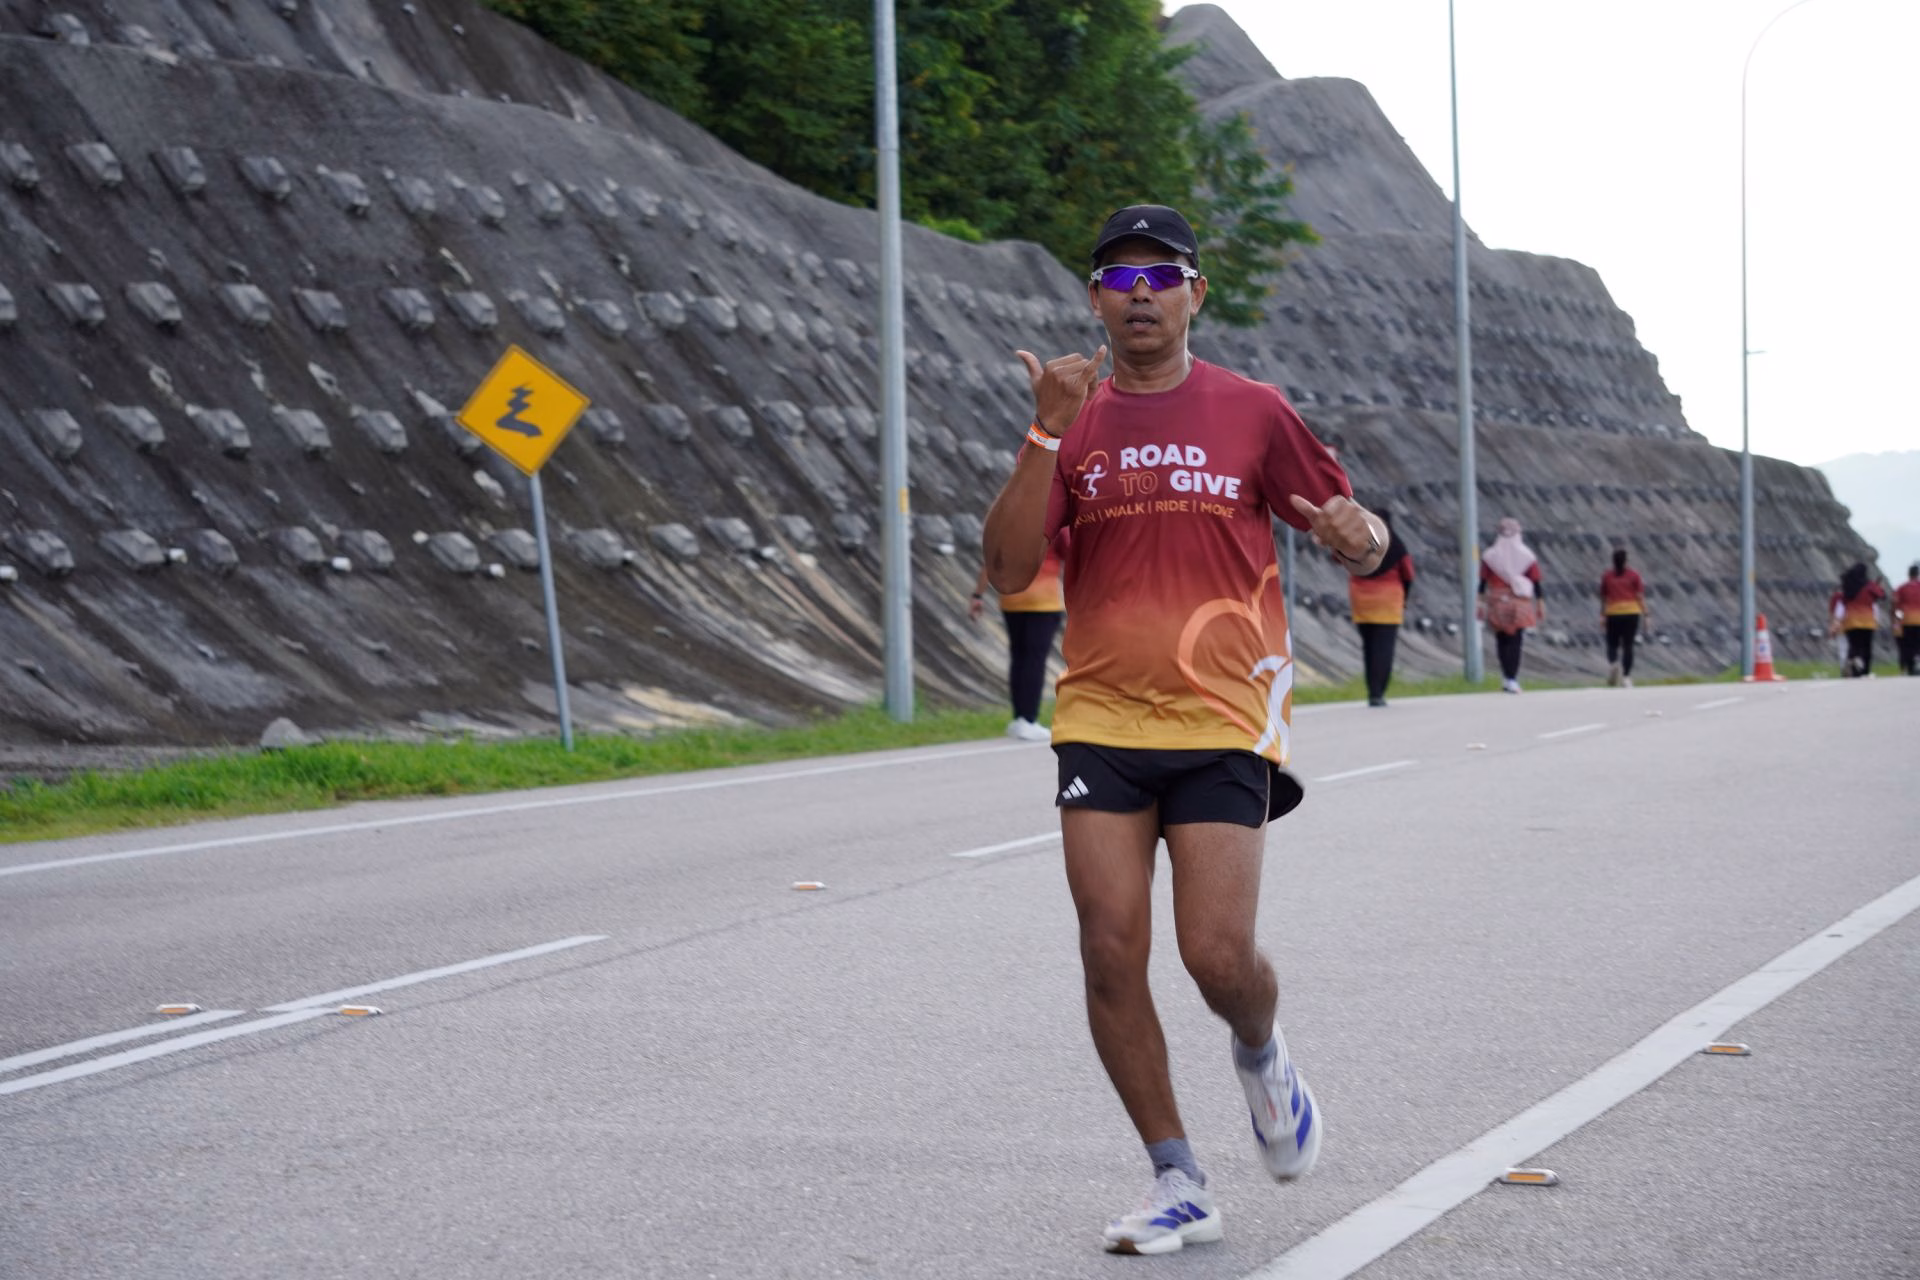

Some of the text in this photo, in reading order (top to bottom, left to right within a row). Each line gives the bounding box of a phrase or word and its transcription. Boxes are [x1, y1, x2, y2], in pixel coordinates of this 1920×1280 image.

[1120, 444, 1207, 470] ROAD
[1118, 469, 1242, 500] TO GIVE
[1103, 502, 1145, 518] WALK
[1155, 499, 1189, 512] RIDE
